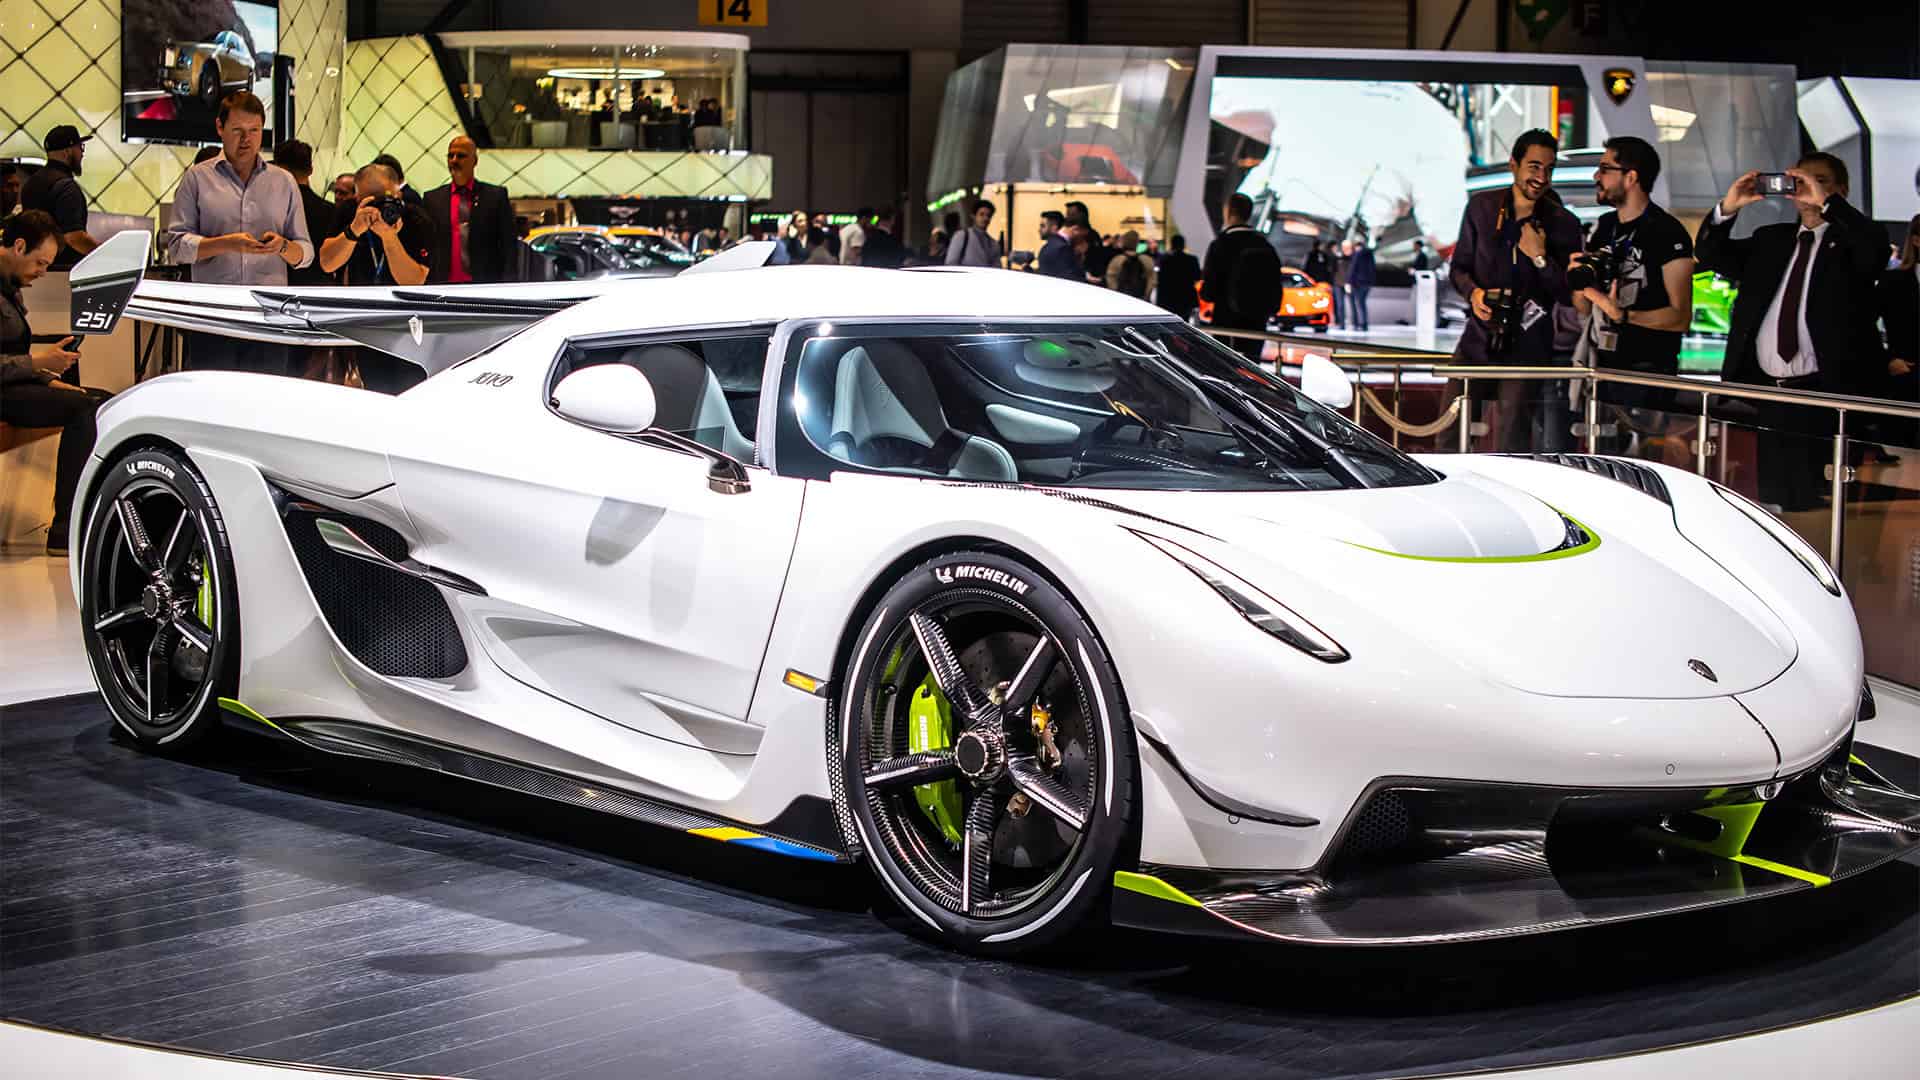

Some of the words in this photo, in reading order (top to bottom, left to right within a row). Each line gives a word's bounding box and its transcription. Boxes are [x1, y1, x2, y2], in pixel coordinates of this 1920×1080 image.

[717, 0, 752, 22] 14
[76, 312, 113, 329] 251
[137, 461, 176, 479] MICHELIN
[955, 565, 1029, 595] MICHELIN
